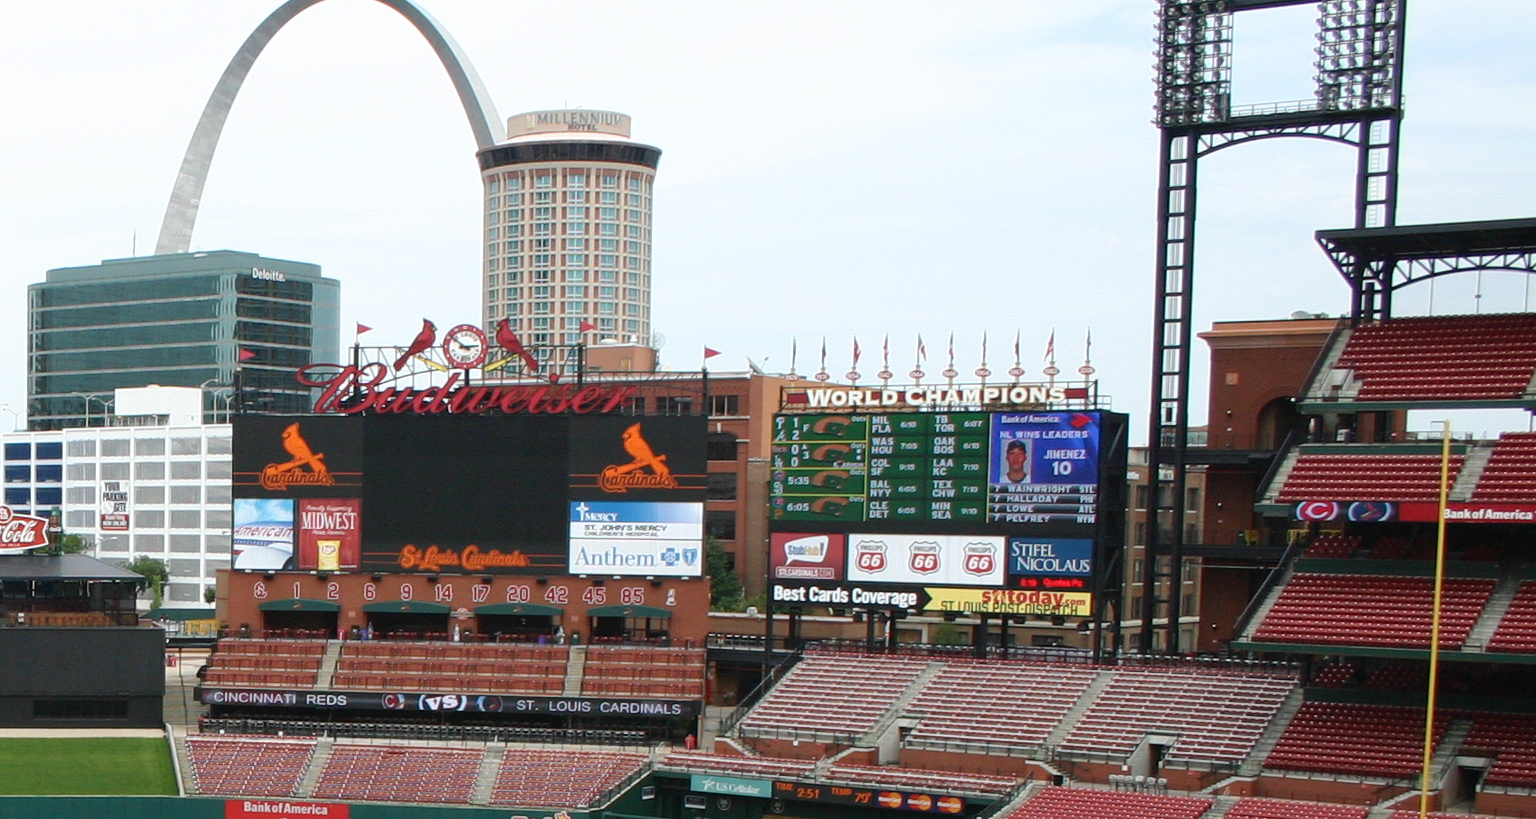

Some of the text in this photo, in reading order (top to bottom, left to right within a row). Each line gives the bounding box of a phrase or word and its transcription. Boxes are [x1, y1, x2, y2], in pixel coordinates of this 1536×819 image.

[537, 112, 622, 125] MILLENNIUM
[296, 362, 638, 414] Budweiser
[806, 386, 1066, 408] WORLD CHAMPIONS
[871, 416, 890, 424] MIL
[935, 415, 948, 423] TB
[1001, 415, 1019, 424] Bank
[1020, 415, 1027, 424] of
[871, 425, 892, 433] FLA
[935, 424, 955, 432] TOR
[792, 430, 800, 441] 2
[1043, 430, 1089, 439] LEADERS
[871, 437, 894, 446] WAS
[933, 437, 955, 446] OAK
[871, 446, 893, 454] HOU
[933, 446, 955, 454] BOS
[1043, 449, 1086, 460] JIMENEZ
[870, 459, 891, 467] COL
[932, 459, 954, 467] LAA
[1051, 461, 1072, 476] 10
[870, 468, 884, 476] SF
[932, 467, 947, 476] KC
[787, 476, 810, 485] 5:35
[870, 480, 890, 488] BAL
[932, 480, 953, 488] TEX
[869, 489, 892, 497] NYY
[932, 489, 956, 498] CHW
[1007, 485, 1071, 493] WAINWRIGHT
[1006, 495, 1059, 503] HALLADAY
[786, 502, 810, 512] 6:05
[869, 501, 889, 510] CLE
[931, 502, 951, 510] MIN
[585, 512, 618, 521] MERCY
[869, 510, 889, 518] DET
[931, 511, 952, 519] SEA
[1443, 508, 1533, 520] Bank of America
[301, 512, 358, 529] MIDWEST
[233, 525, 293, 537] American
[1011, 541, 1055, 557] STIFEL
[574, 546, 655, 567] Anthem
[861, 554, 881, 567] 66
[914, 555, 935, 568] 66
[968, 556, 990, 570] 66
[1017, 557, 1090, 573] NICOLAUS
[293, 581, 301, 598] 1
[327, 582, 339, 599] 2
[364, 583, 376, 600] 6
[400, 583, 413, 601] 9
[435, 583, 453, 601] 14
[472, 585, 490, 602] 17
[507, 585, 530, 602] 20
[545, 586, 568, 604] 42
[582, 586, 606, 604] 45
[620, 587, 644, 605] 85
[773, 585, 917, 608] Best Cards Coverage
[213, 691, 296, 705] CINCINNATI
[306, 693, 347, 706] REDS
[516, 700, 539, 711] ST.
[549, 701, 591, 712] LOUIS
[600, 702, 681, 714] CARDINALS
[797, 787, 820, 799] 2:51
[244, 801, 328, 815] Bank of America
